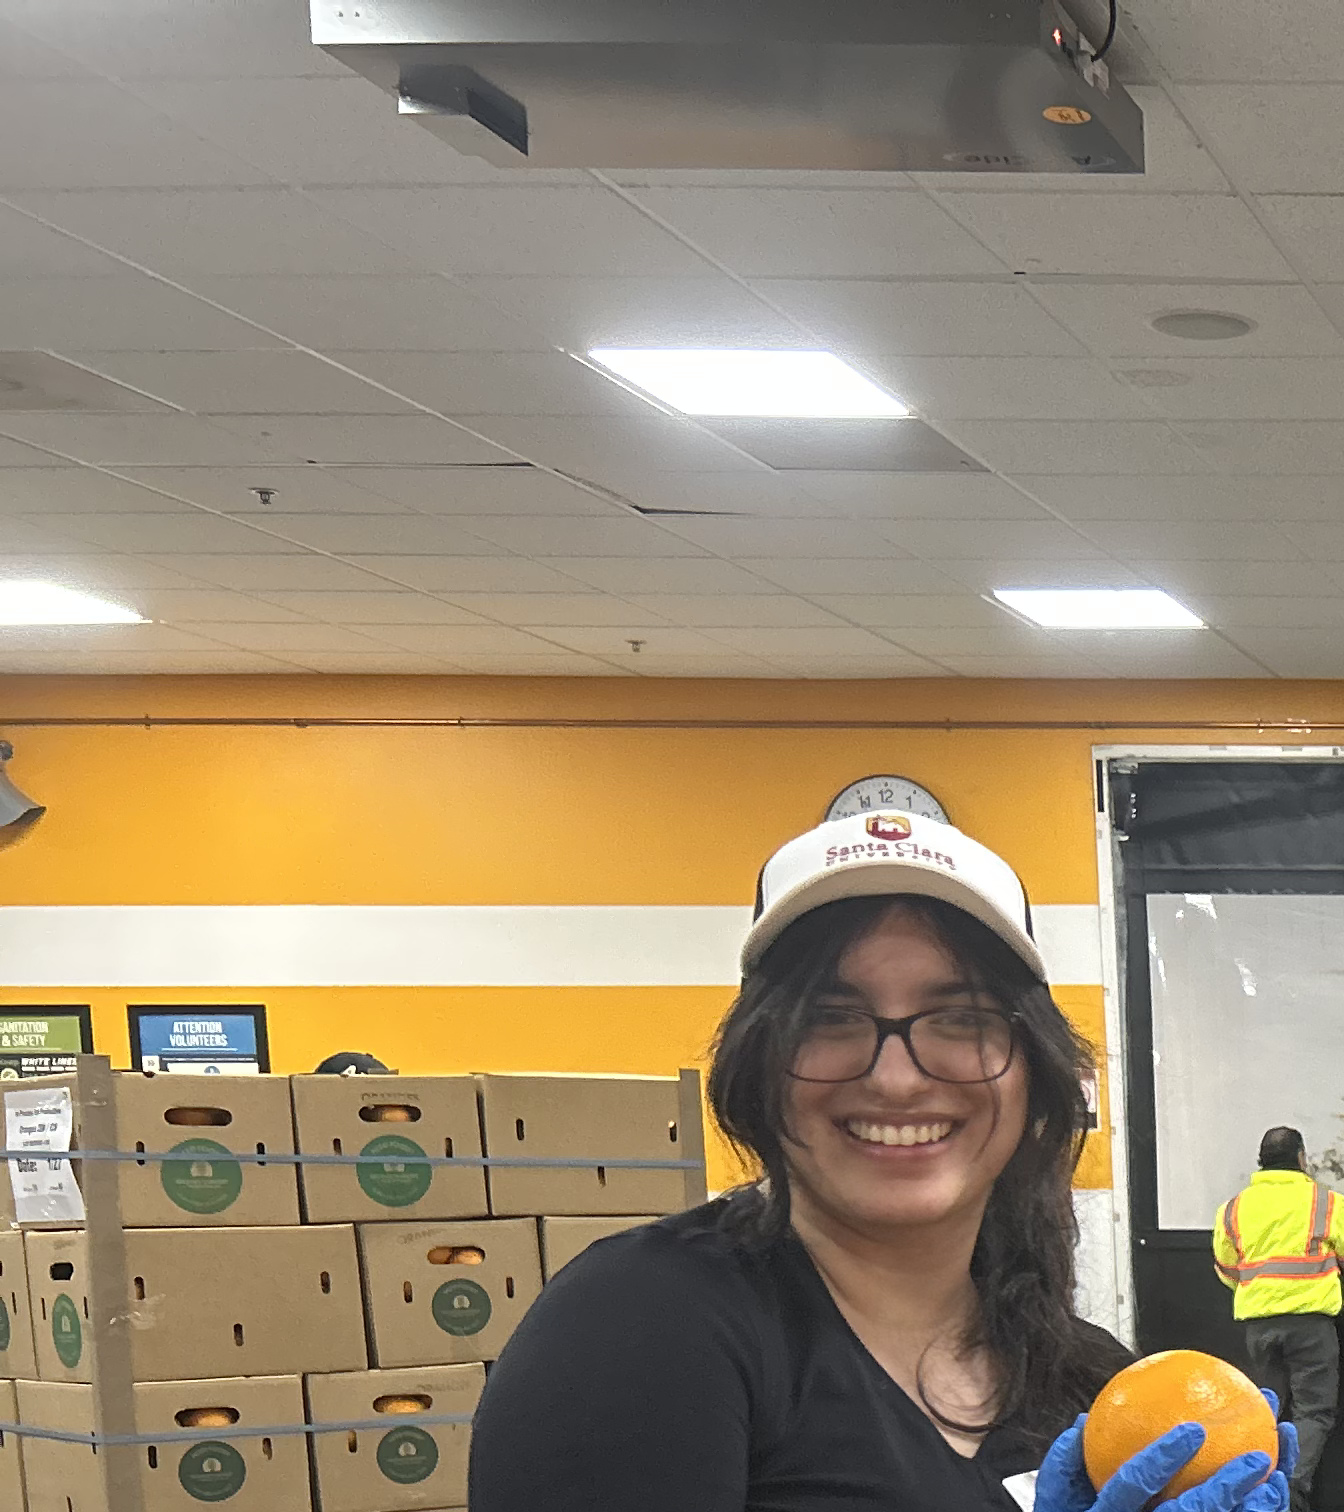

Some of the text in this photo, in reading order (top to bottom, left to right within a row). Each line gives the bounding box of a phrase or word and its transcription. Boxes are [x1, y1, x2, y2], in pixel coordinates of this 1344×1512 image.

[878, 789, 894, 803] 12
[905, 795, 912, 809] 1
[826, 842, 956, 867] Santa Clara
[173, 1022, 223, 1033] ATTENTION
[12, 1035, 46, 1047] SAFETY
[169, 1034, 228, 1047] VOLUNTEERS
